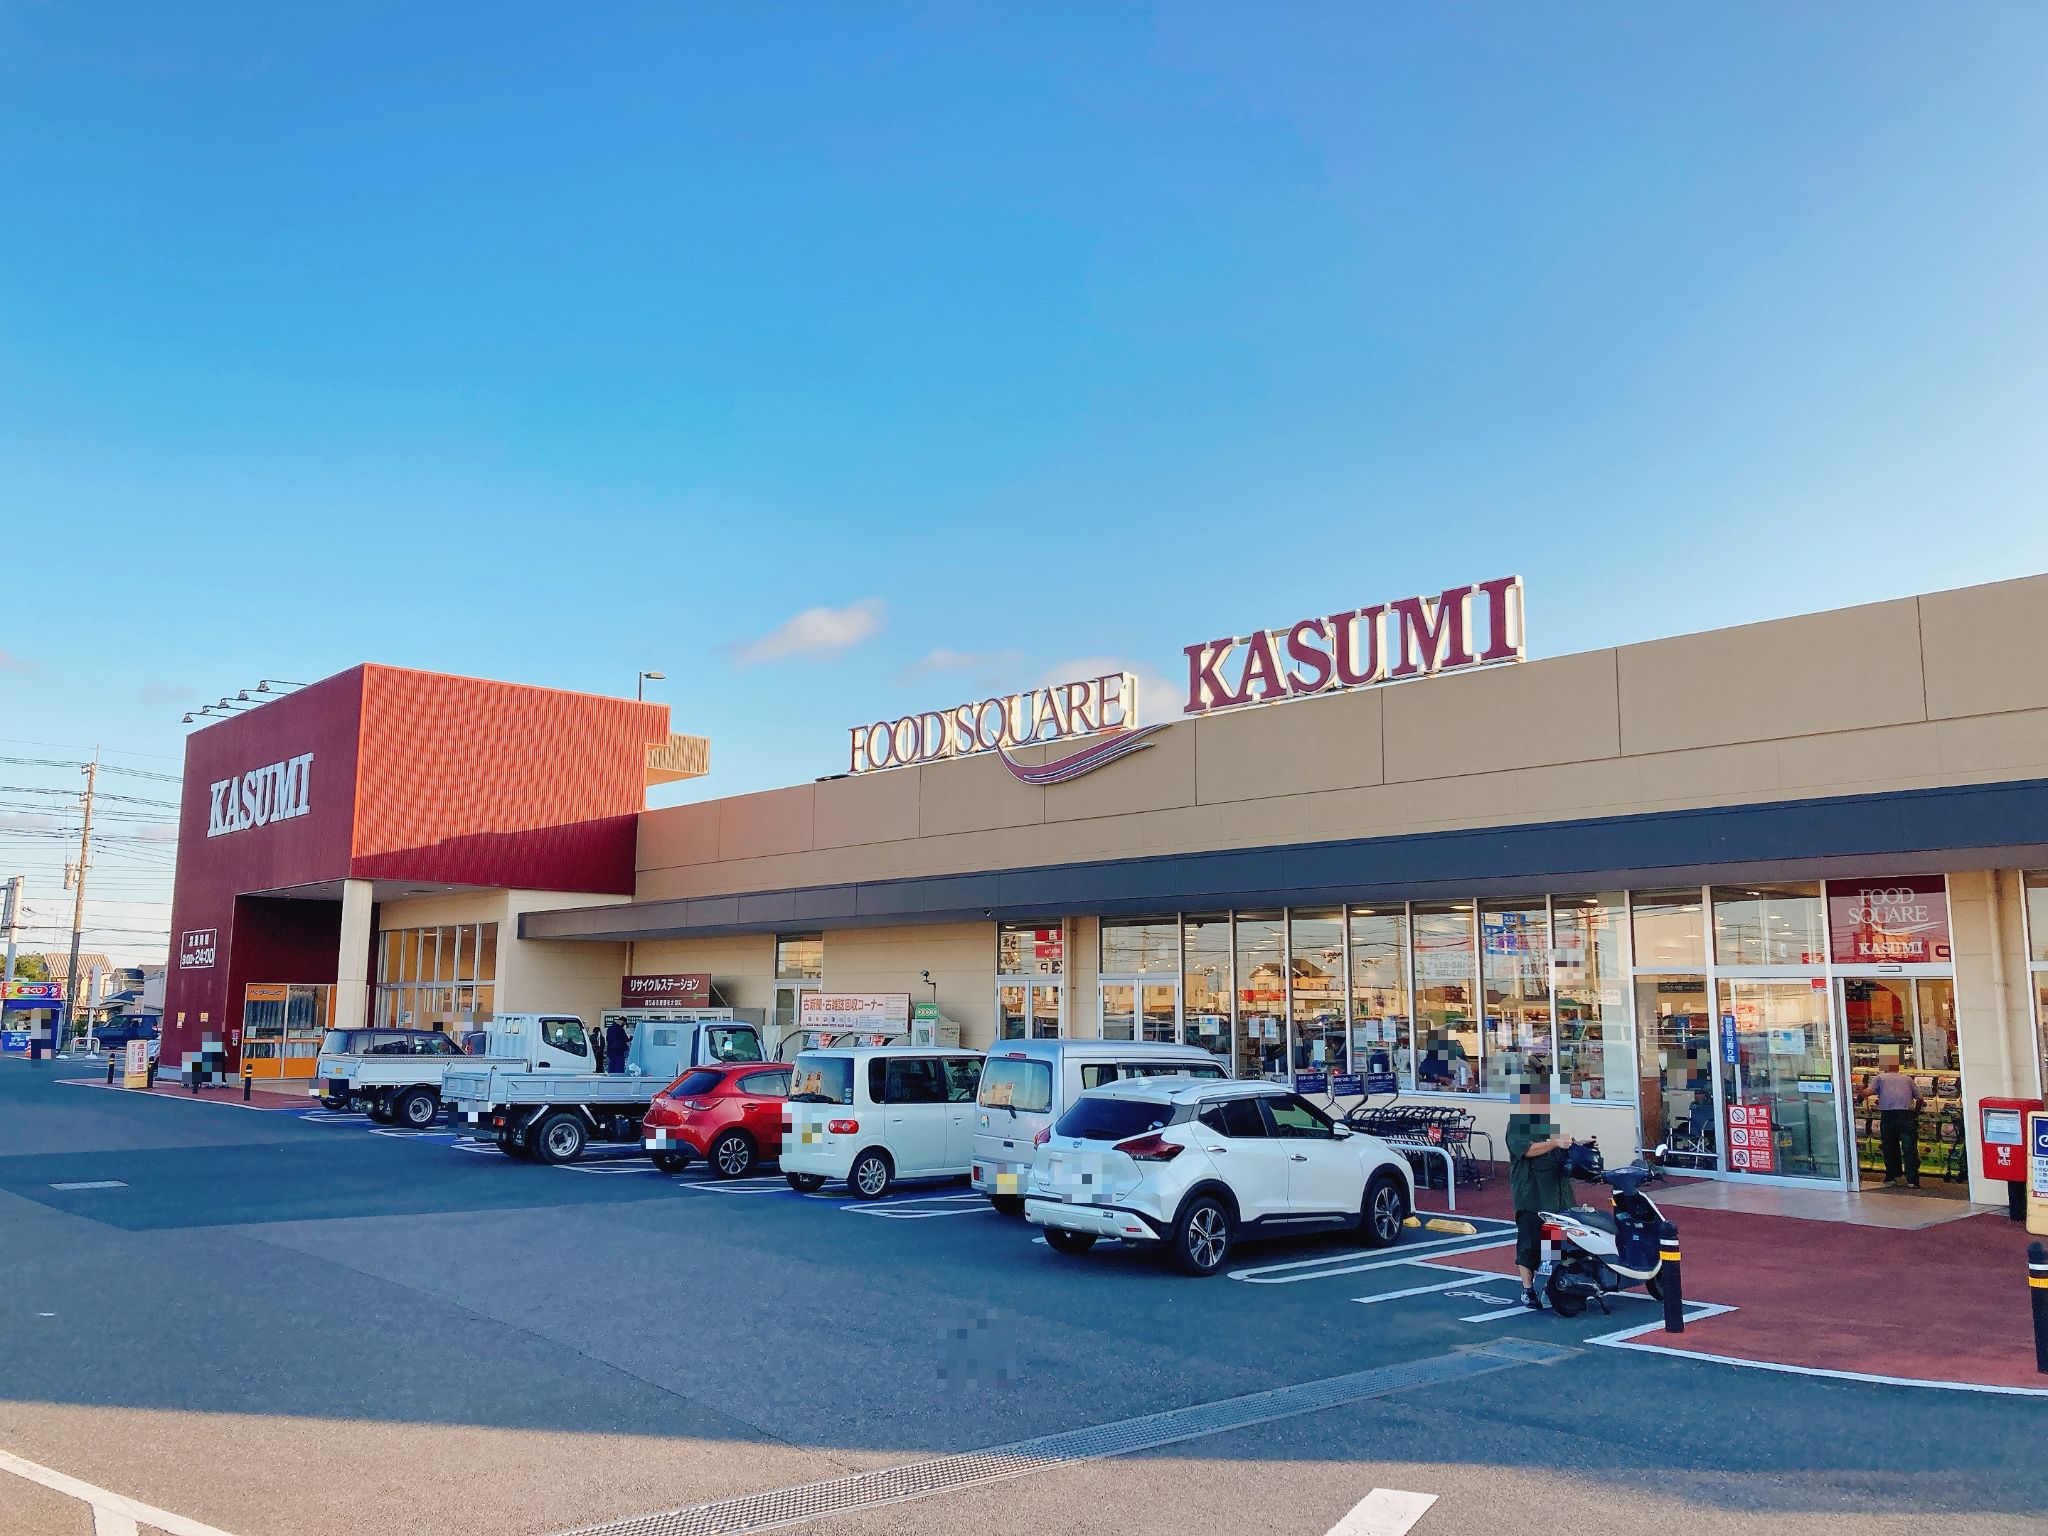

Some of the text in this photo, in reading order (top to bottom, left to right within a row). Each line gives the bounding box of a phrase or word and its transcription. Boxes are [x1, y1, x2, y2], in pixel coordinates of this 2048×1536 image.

[1184, 575, 1525, 716] KASUMI
[206, 752, 315, 838] KASUMI
[1859, 887, 1914, 906] FOOD
[1848, 905, 1929, 924] SQUARE
[1859, 941, 1924, 955] KASUMI
[630, 978, 699, 992] リサイクルステーション
